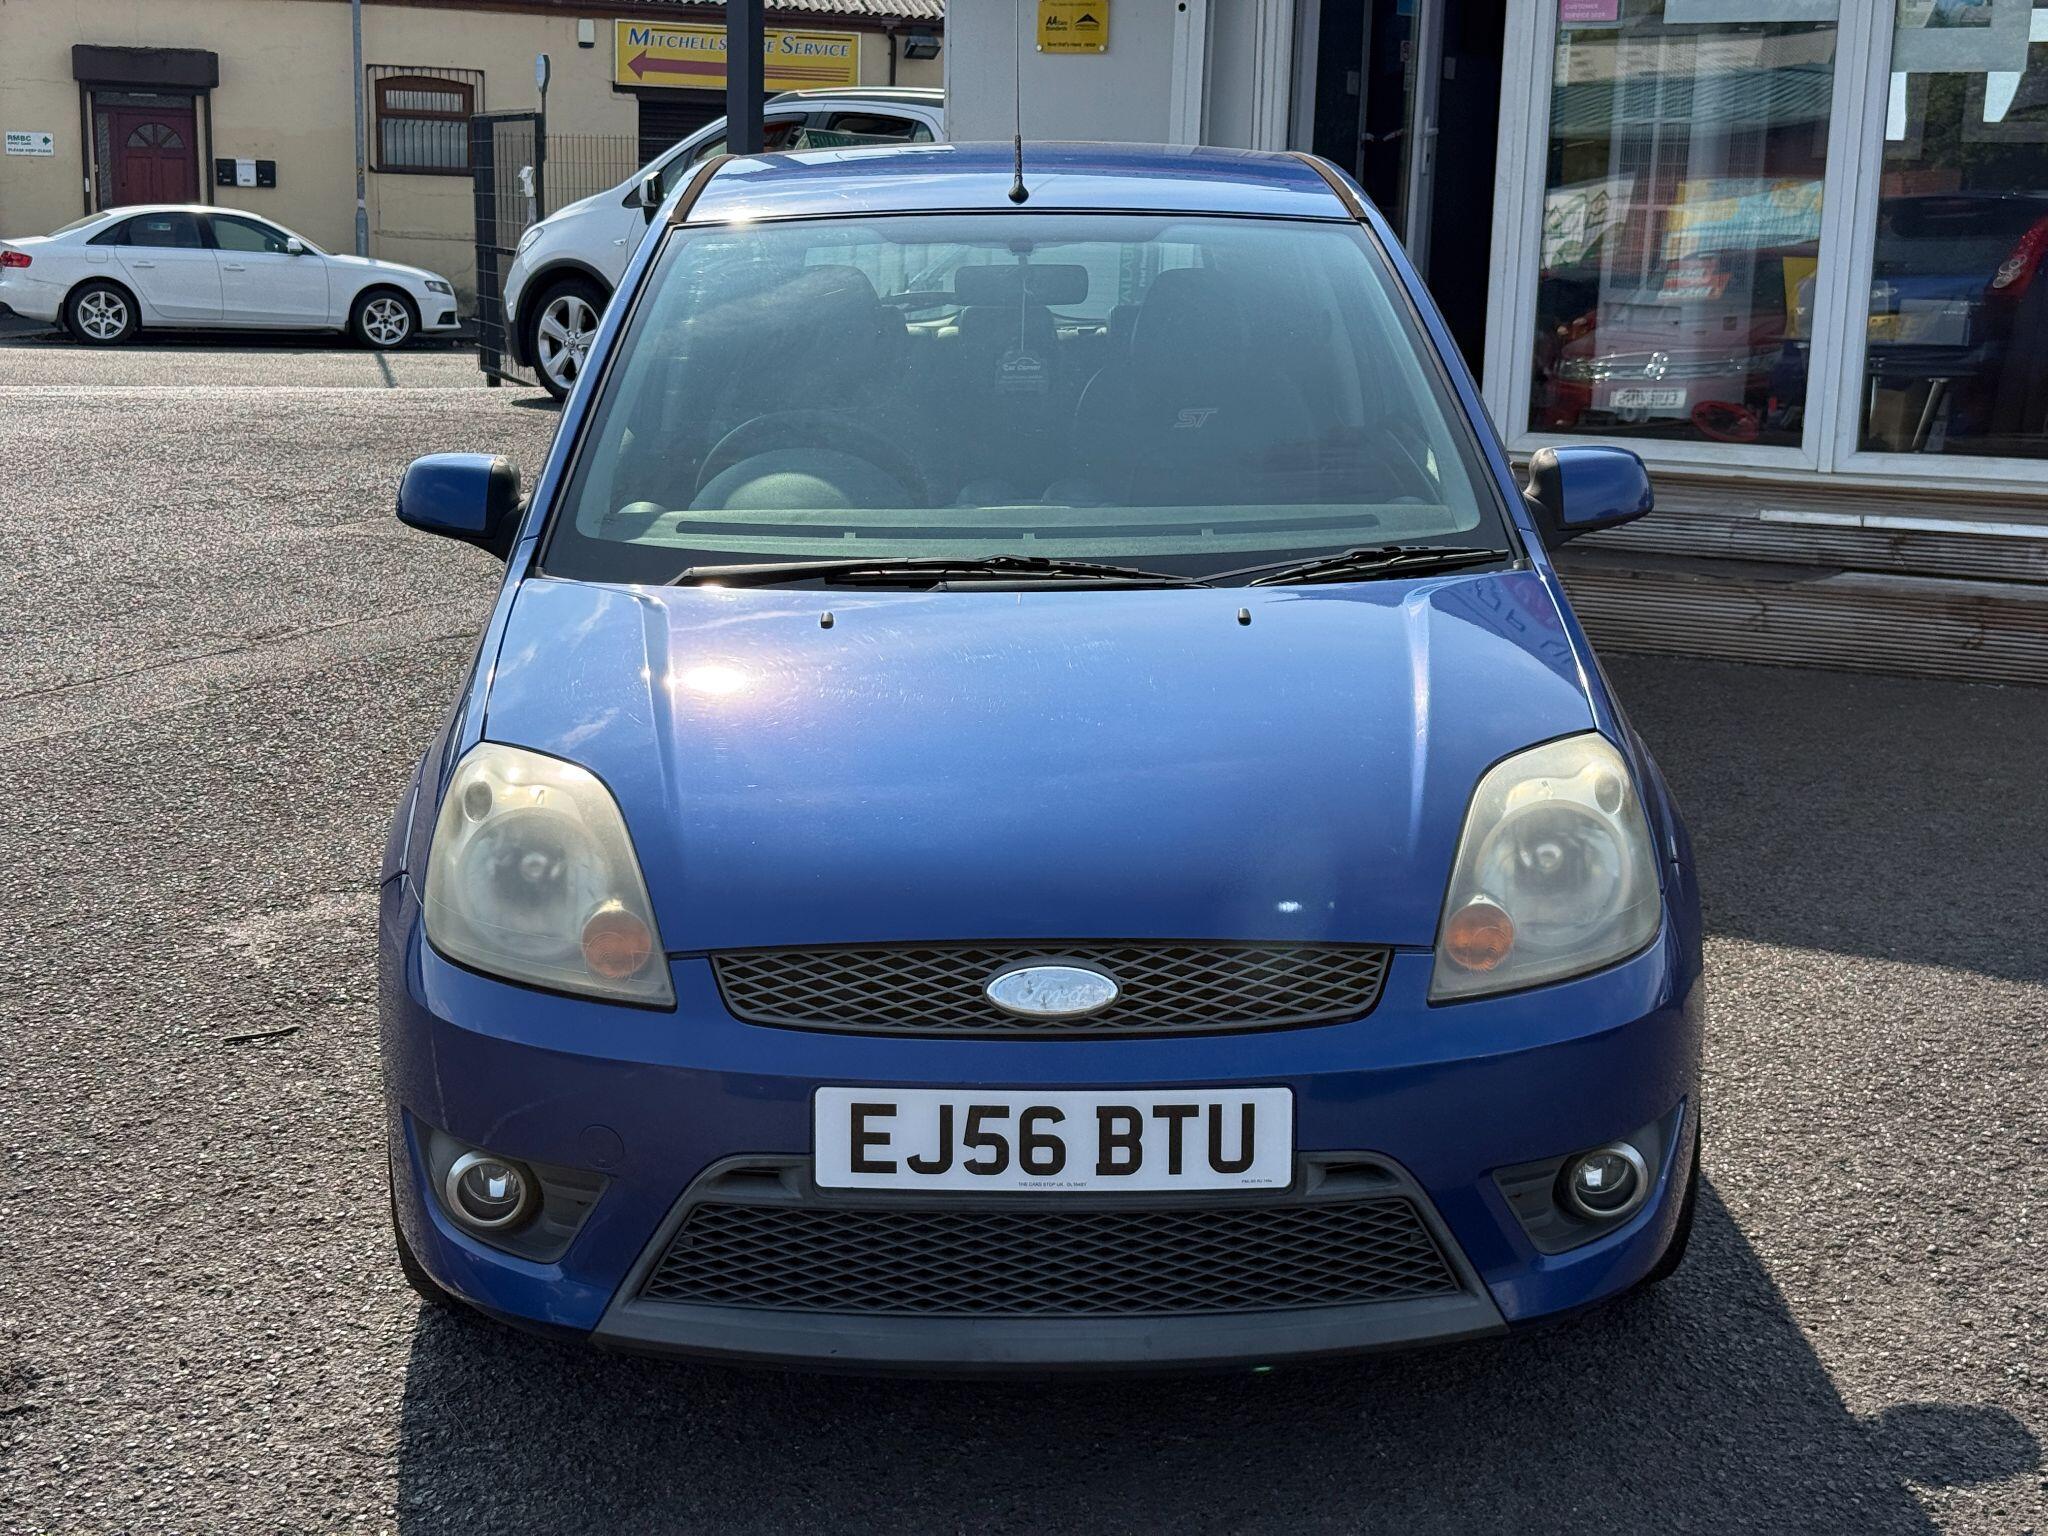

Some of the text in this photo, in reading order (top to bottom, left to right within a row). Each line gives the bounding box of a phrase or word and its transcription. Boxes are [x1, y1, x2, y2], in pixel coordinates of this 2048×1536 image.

[628, 27, 726, 50] MITCHELLS
[780, 35, 849, 57] SERVICE
[7, 134, 32, 142] RMBC
[850, 1102, 1256, 1177] EJ56 BTU
